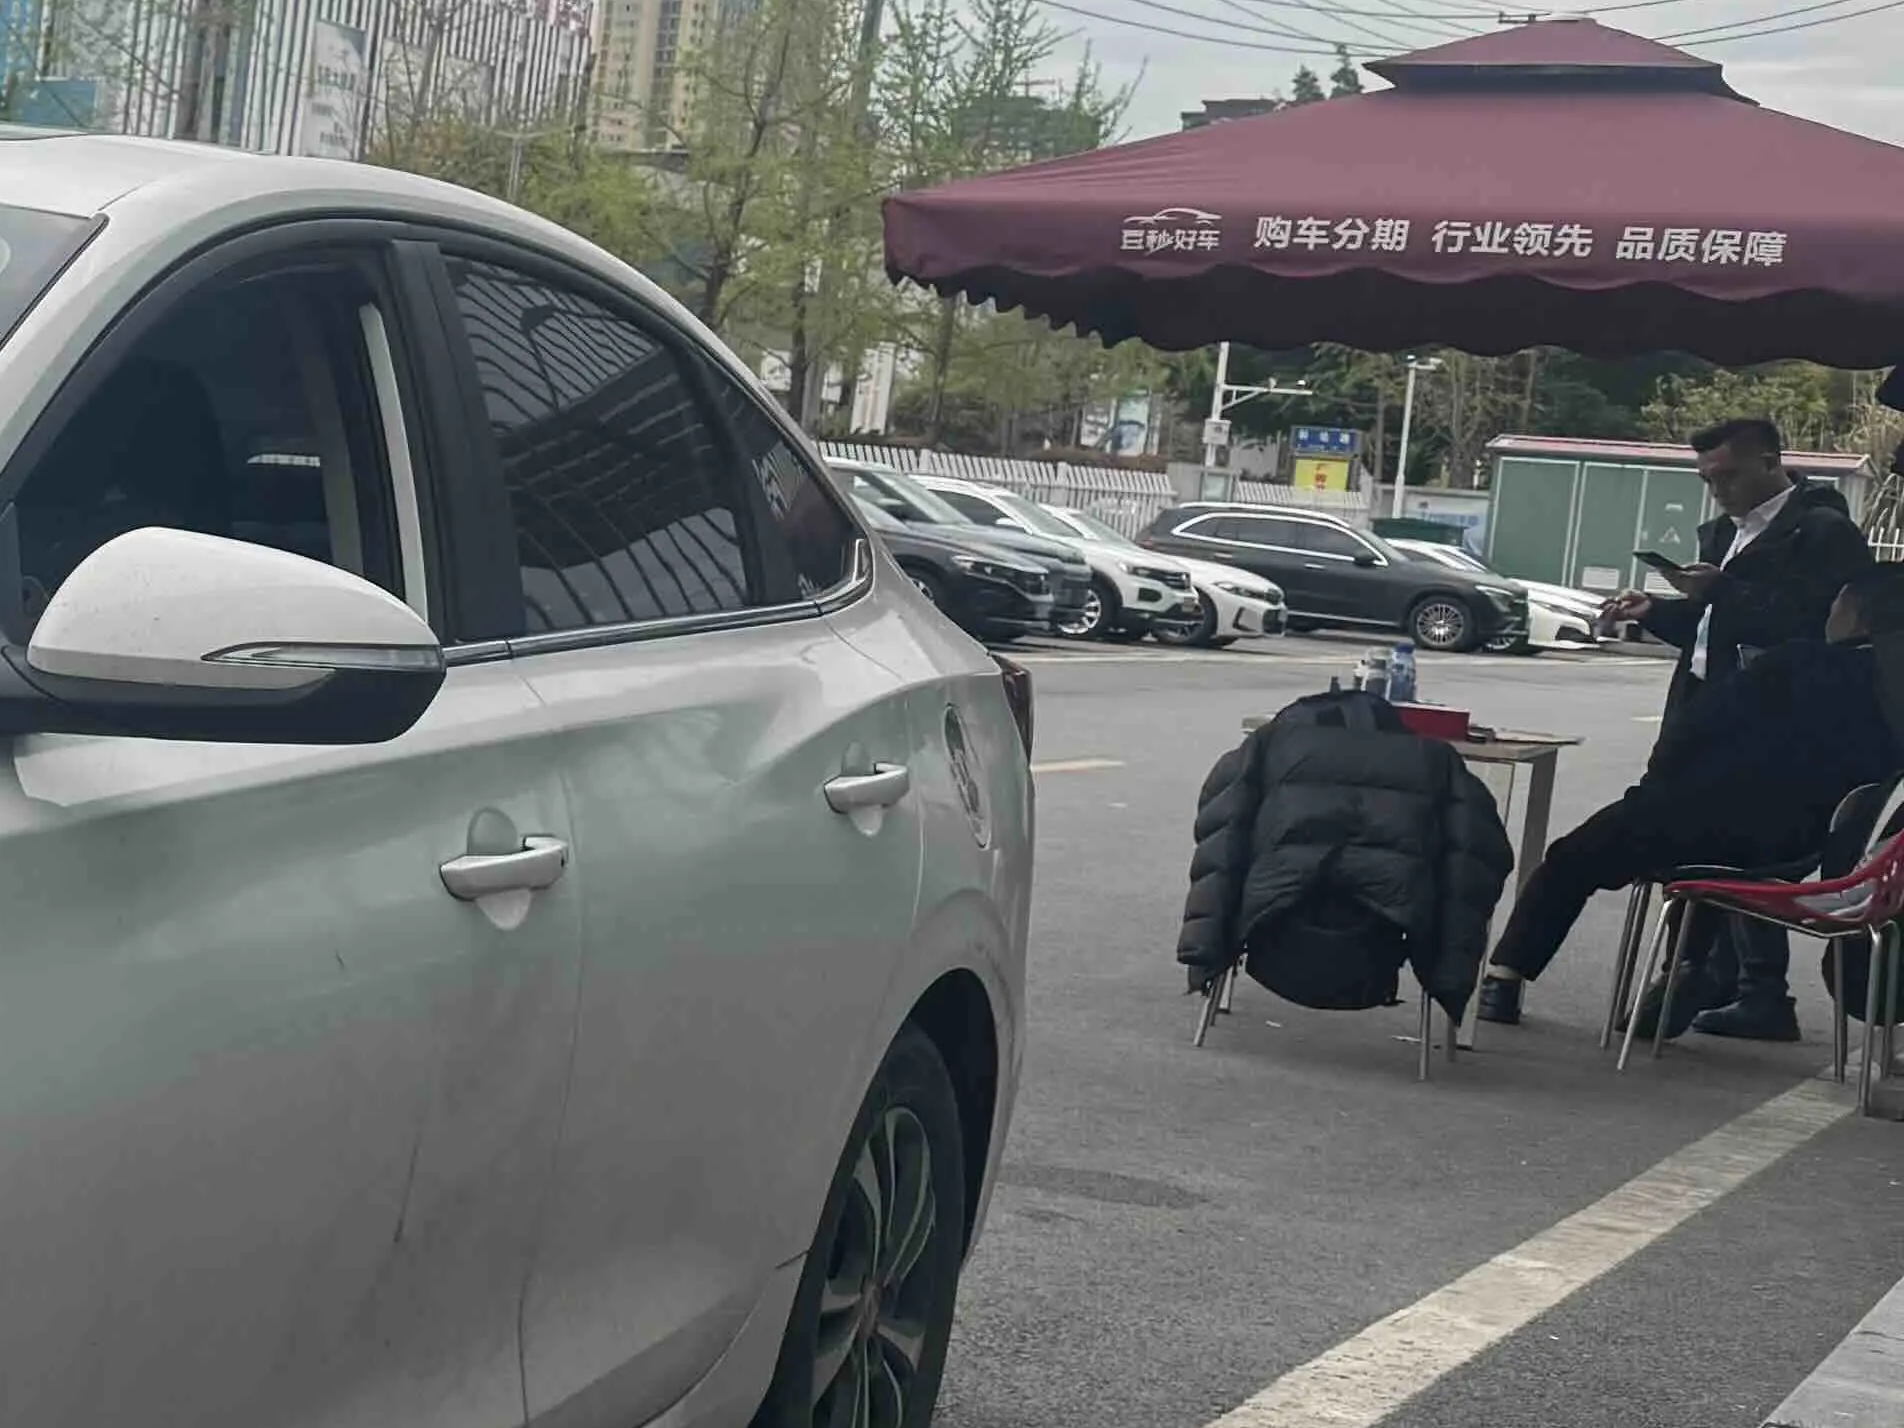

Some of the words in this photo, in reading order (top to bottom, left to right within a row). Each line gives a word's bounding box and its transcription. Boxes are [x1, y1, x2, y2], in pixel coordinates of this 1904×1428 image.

[1254, 216, 1410, 252] 购车分期
[1432, 221, 1594, 258] 行业领先
[1616, 227, 1788, 266] 品质保障
